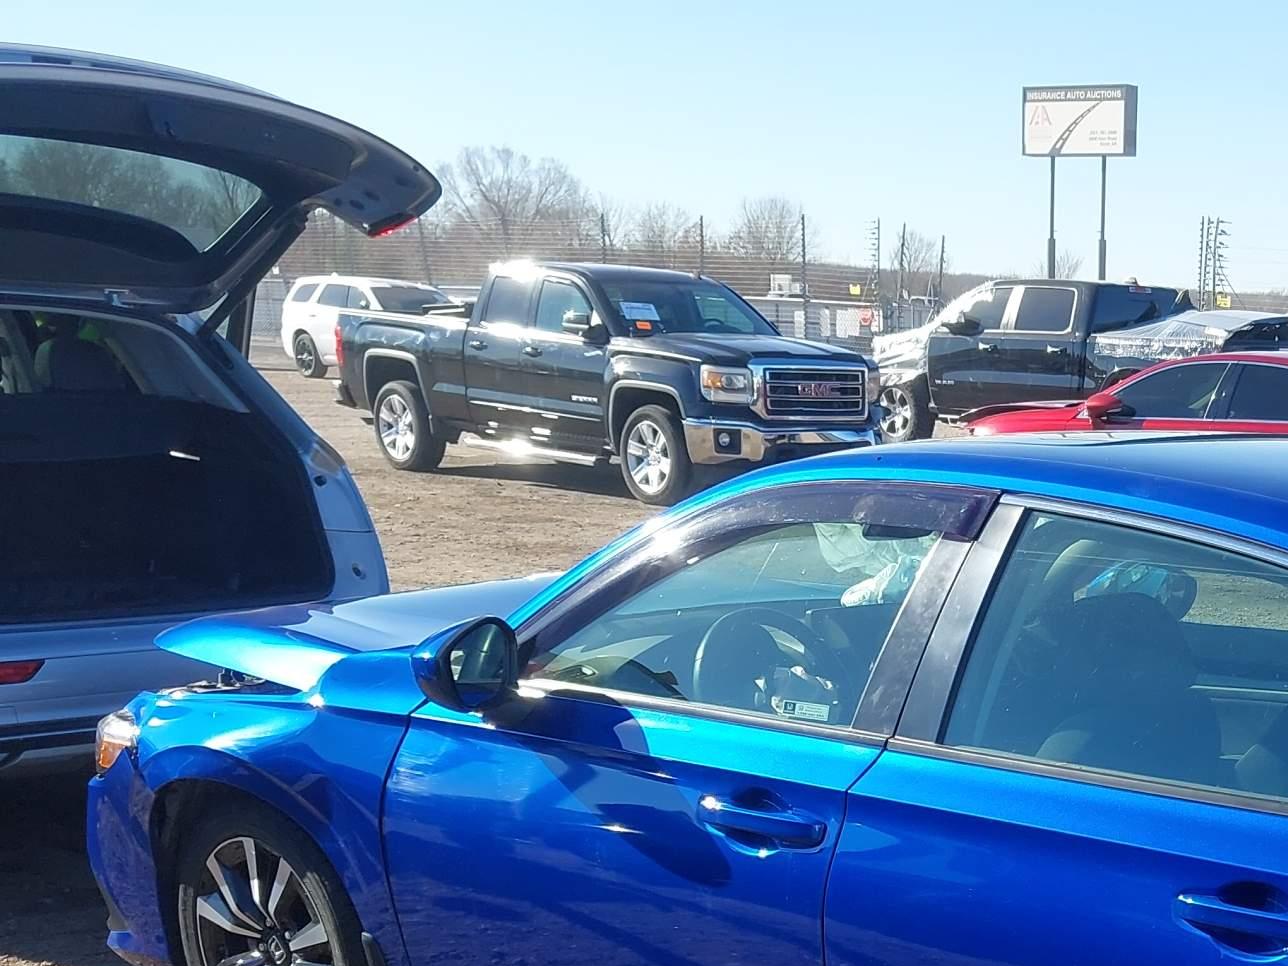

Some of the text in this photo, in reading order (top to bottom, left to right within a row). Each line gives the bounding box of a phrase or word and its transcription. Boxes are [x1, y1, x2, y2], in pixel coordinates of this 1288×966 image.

[1026, 89, 1122, 100] INSURANCE AUTO AUCTIONS
[798, 383, 841, 397] GMC
